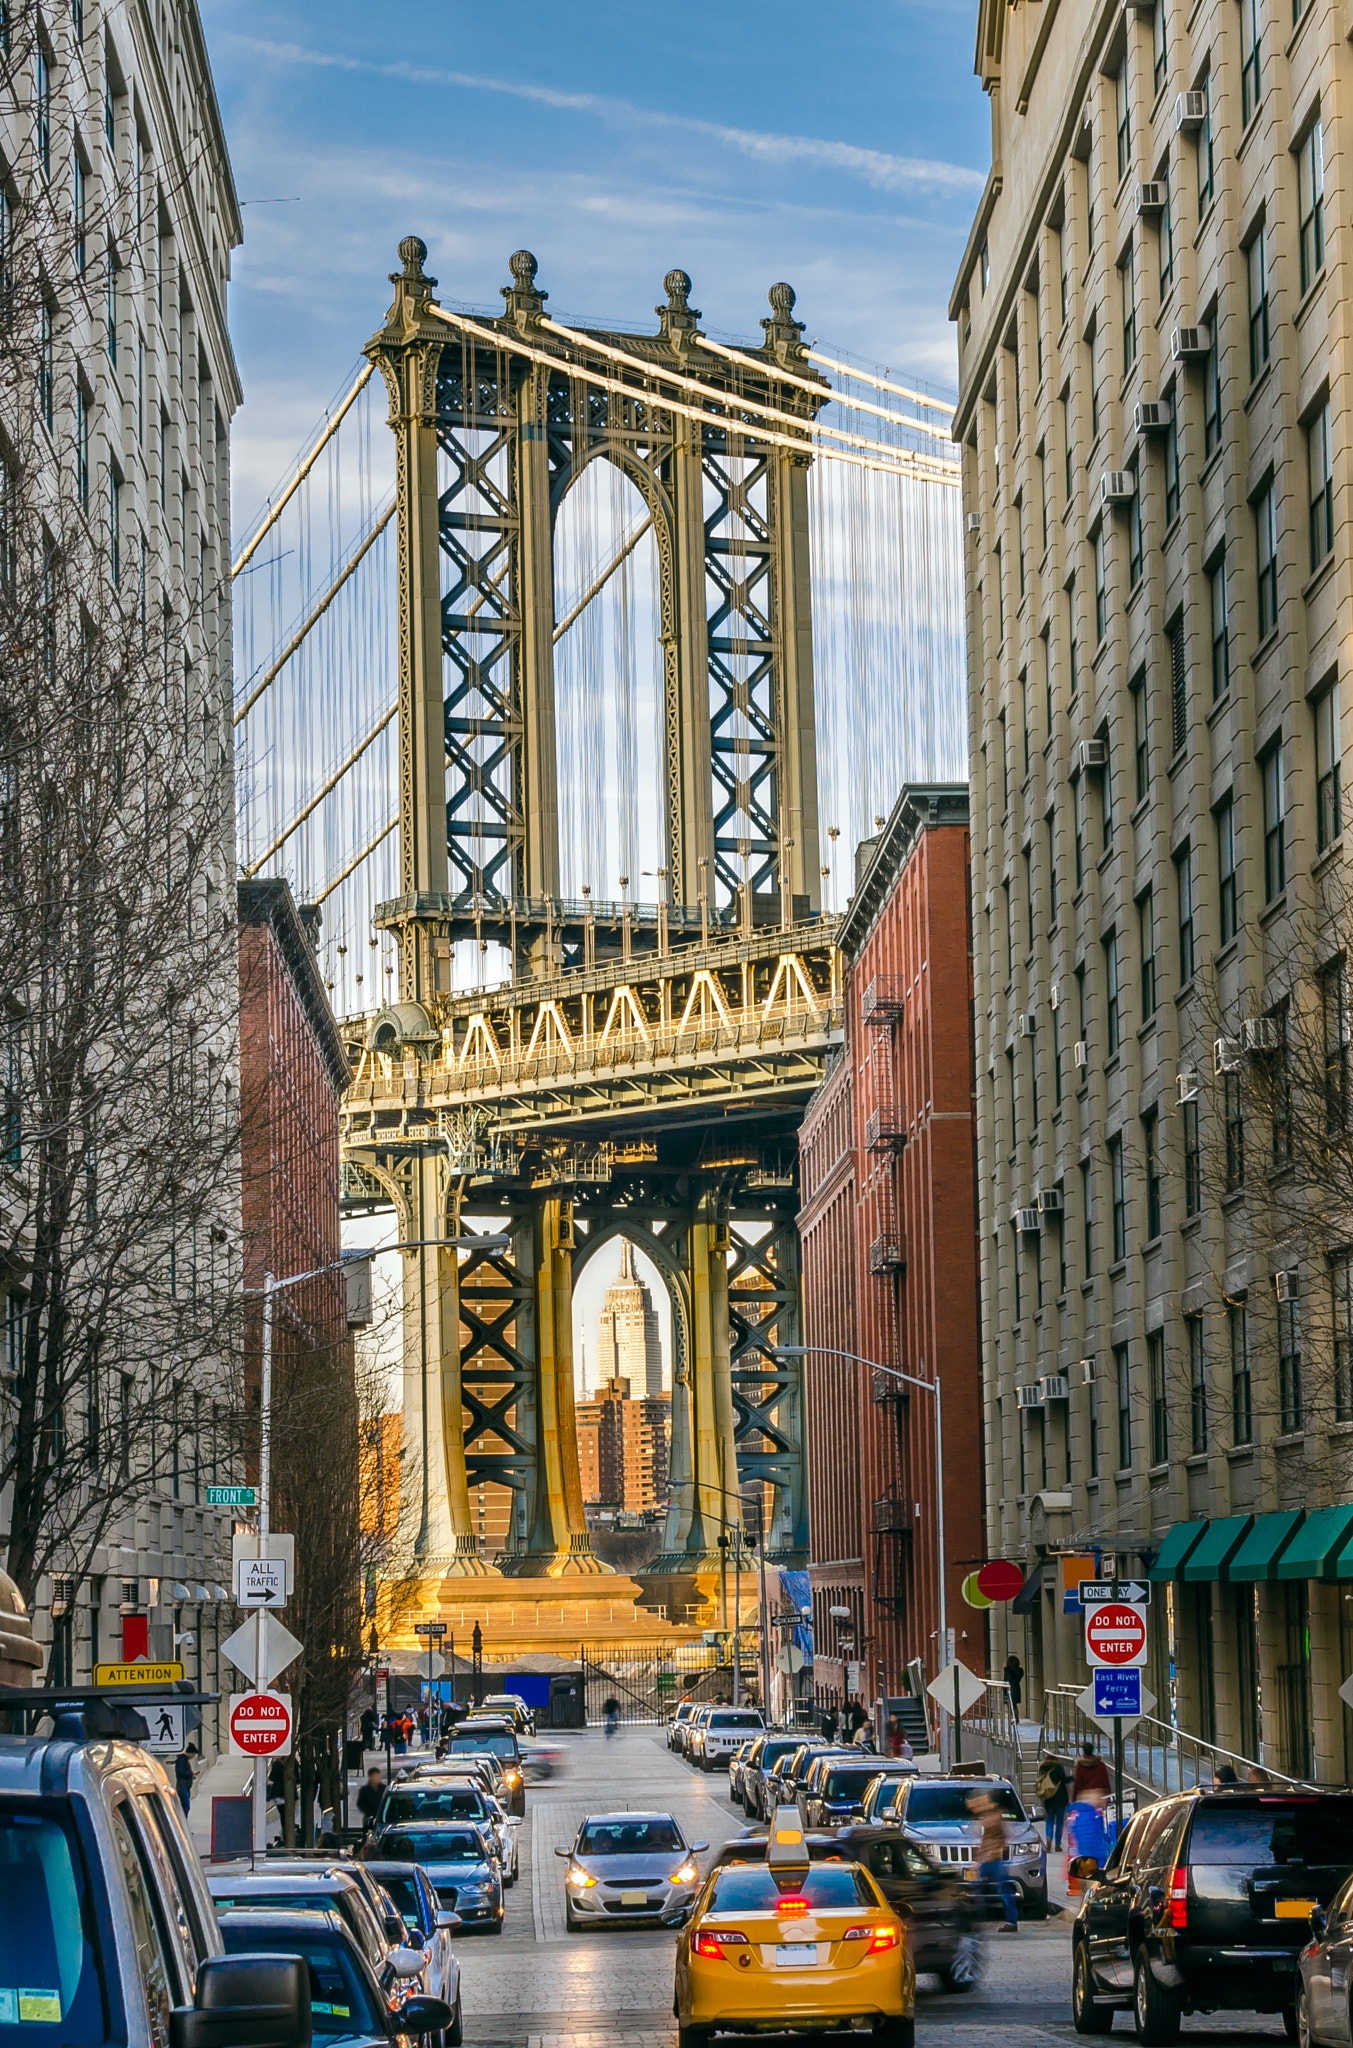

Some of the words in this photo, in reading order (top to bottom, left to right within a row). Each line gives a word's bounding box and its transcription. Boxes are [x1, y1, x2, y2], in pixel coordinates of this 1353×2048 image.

[210, 1489, 242, 1502] FRONT
[251, 1563, 274, 1574] ALL
[246, 1577, 278, 1586] TRAFFIC
[1087, 1588, 1106, 1597] ONE
[1095, 1616, 1110, 1626] DO
[1116, 1616, 1136, 1626] NOT
[1100, 1643, 1133, 1653] ENTER
[109, 1669, 171, 1680] ATTENTION
[1117, 1673, 1138, 1681] River
[1105, 1685, 1128, 1694] Ferry
[239, 1707, 254, 1717] DO
[260, 1707, 281, 1717] NOT
[243, 1733, 277, 1743] ENTER
